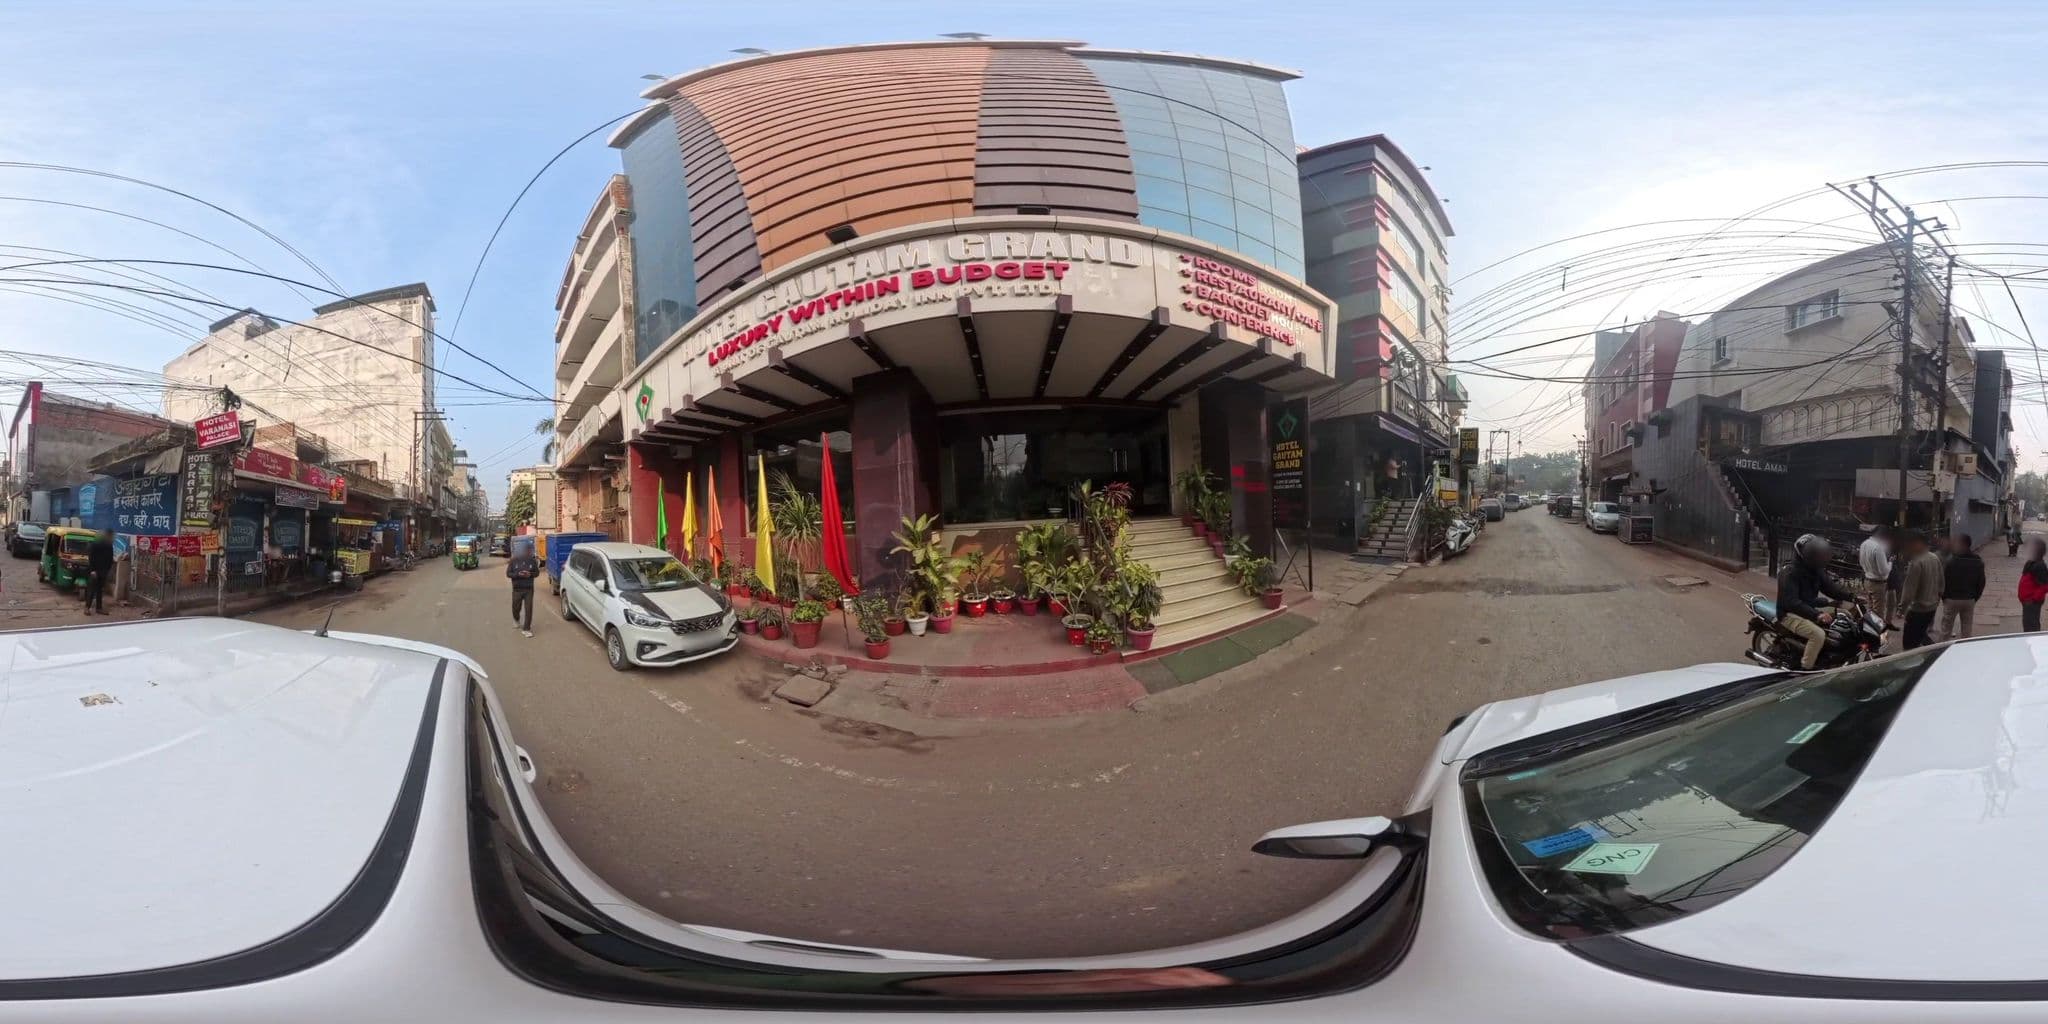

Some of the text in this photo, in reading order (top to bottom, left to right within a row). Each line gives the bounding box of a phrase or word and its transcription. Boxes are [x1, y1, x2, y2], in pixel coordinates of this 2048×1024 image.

[1194, 256, 1257, 288] ROOMS
[682, 231, 1143, 367] HOTEL GAUTAM GRAND
[914, 287, 953, 306] INN
[1195, 286, 1270, 322] BANQUET
[708, 260, 1071, 367] LUXURY WITHIN BUDGET
[1197, 302, 1297, 347] CONFERENCE
[199, 421, 237, 437] VARANASI
[202, 415, 230, 427] HOTEL
[206, 431, 230, 441] PALACE
[1275, 441, 1300, 452] HOTEL
[187, 454, 209, 463] HOTE
[1272, 449, 1304, 462] GAUTAM
[1274, 459, 1301, 470] GRAND
[1735, 458, 1762, 471] HOTEL
[1587, 848, 1641, 867] CNG
